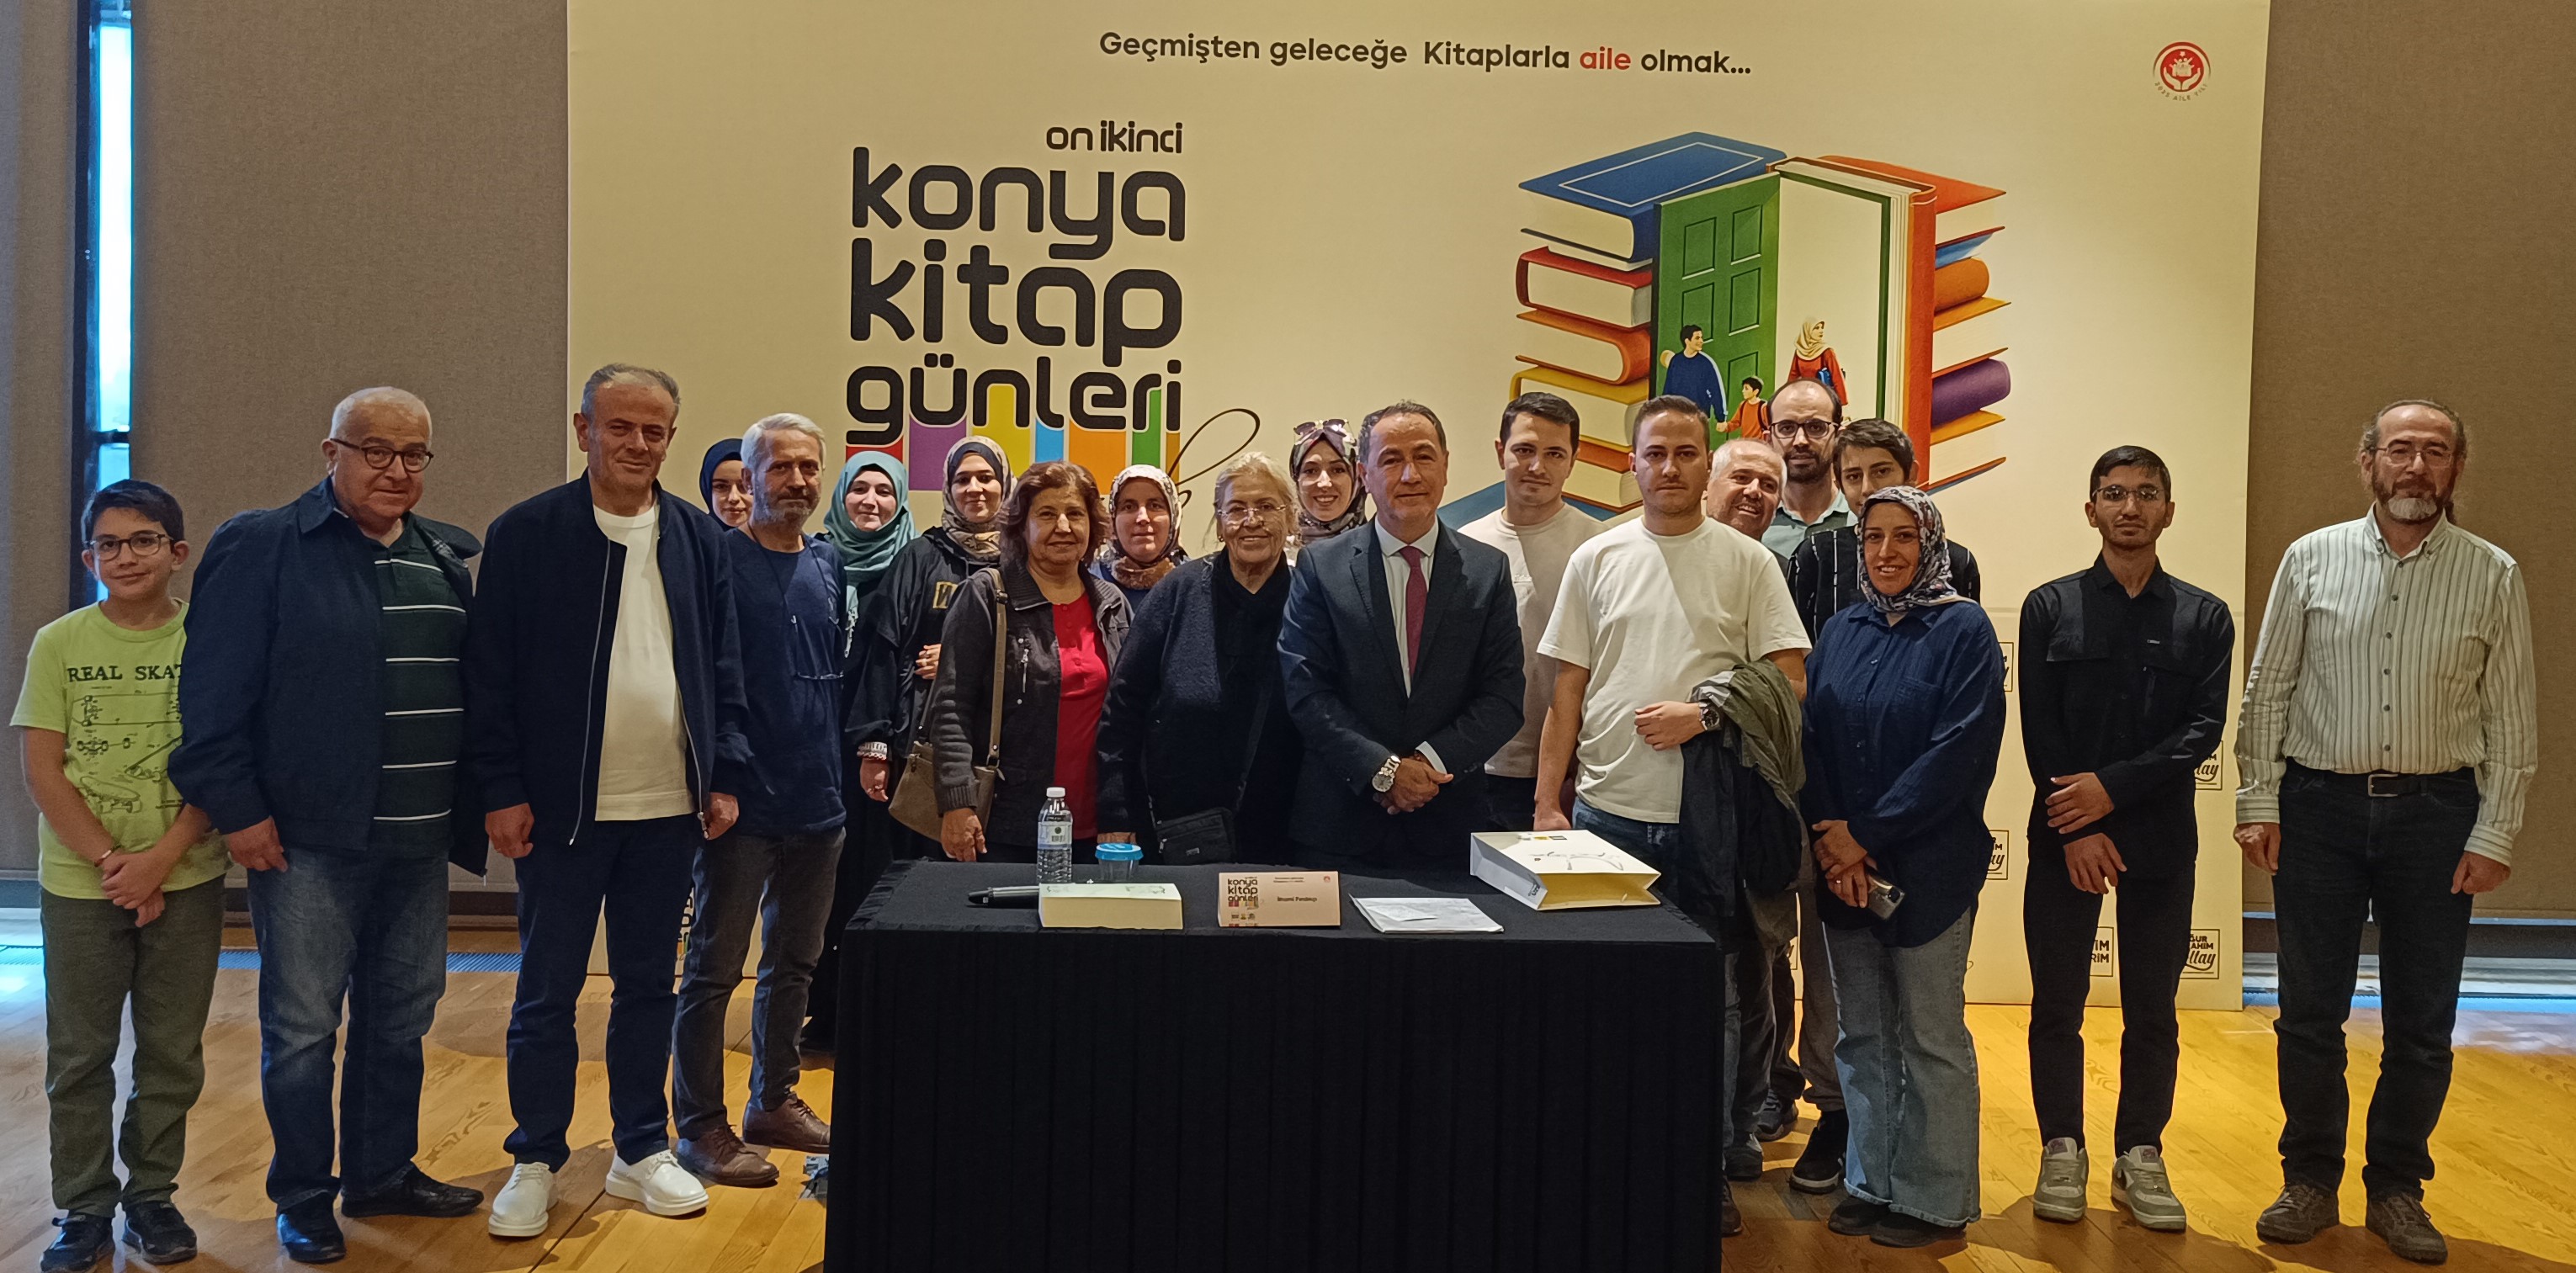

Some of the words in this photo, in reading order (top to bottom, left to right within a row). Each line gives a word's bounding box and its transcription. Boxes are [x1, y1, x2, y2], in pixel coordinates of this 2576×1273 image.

[1099, 31, 1261, 64] Geçmişten
[1269, 37, 1408, 70] geleceğe
[1424, 40, 1570, 74] Kitaplarla
[1579, 45, 1633, 72] aile
[1640, 49, 1751, 75] olmak...
[1046, 126, 1093, 151] on
[1100, 119, 1183, 154] ikinci
[852, 146, 1186, 261] konya
[850, 237, 1182, 368] kitap
[845, 353, 1182, 446] günleri
[66, 665, 123, 683] REAL
[1228, 878, 1258, 887] konya
[1228, 886, 1258, 897] kitap
